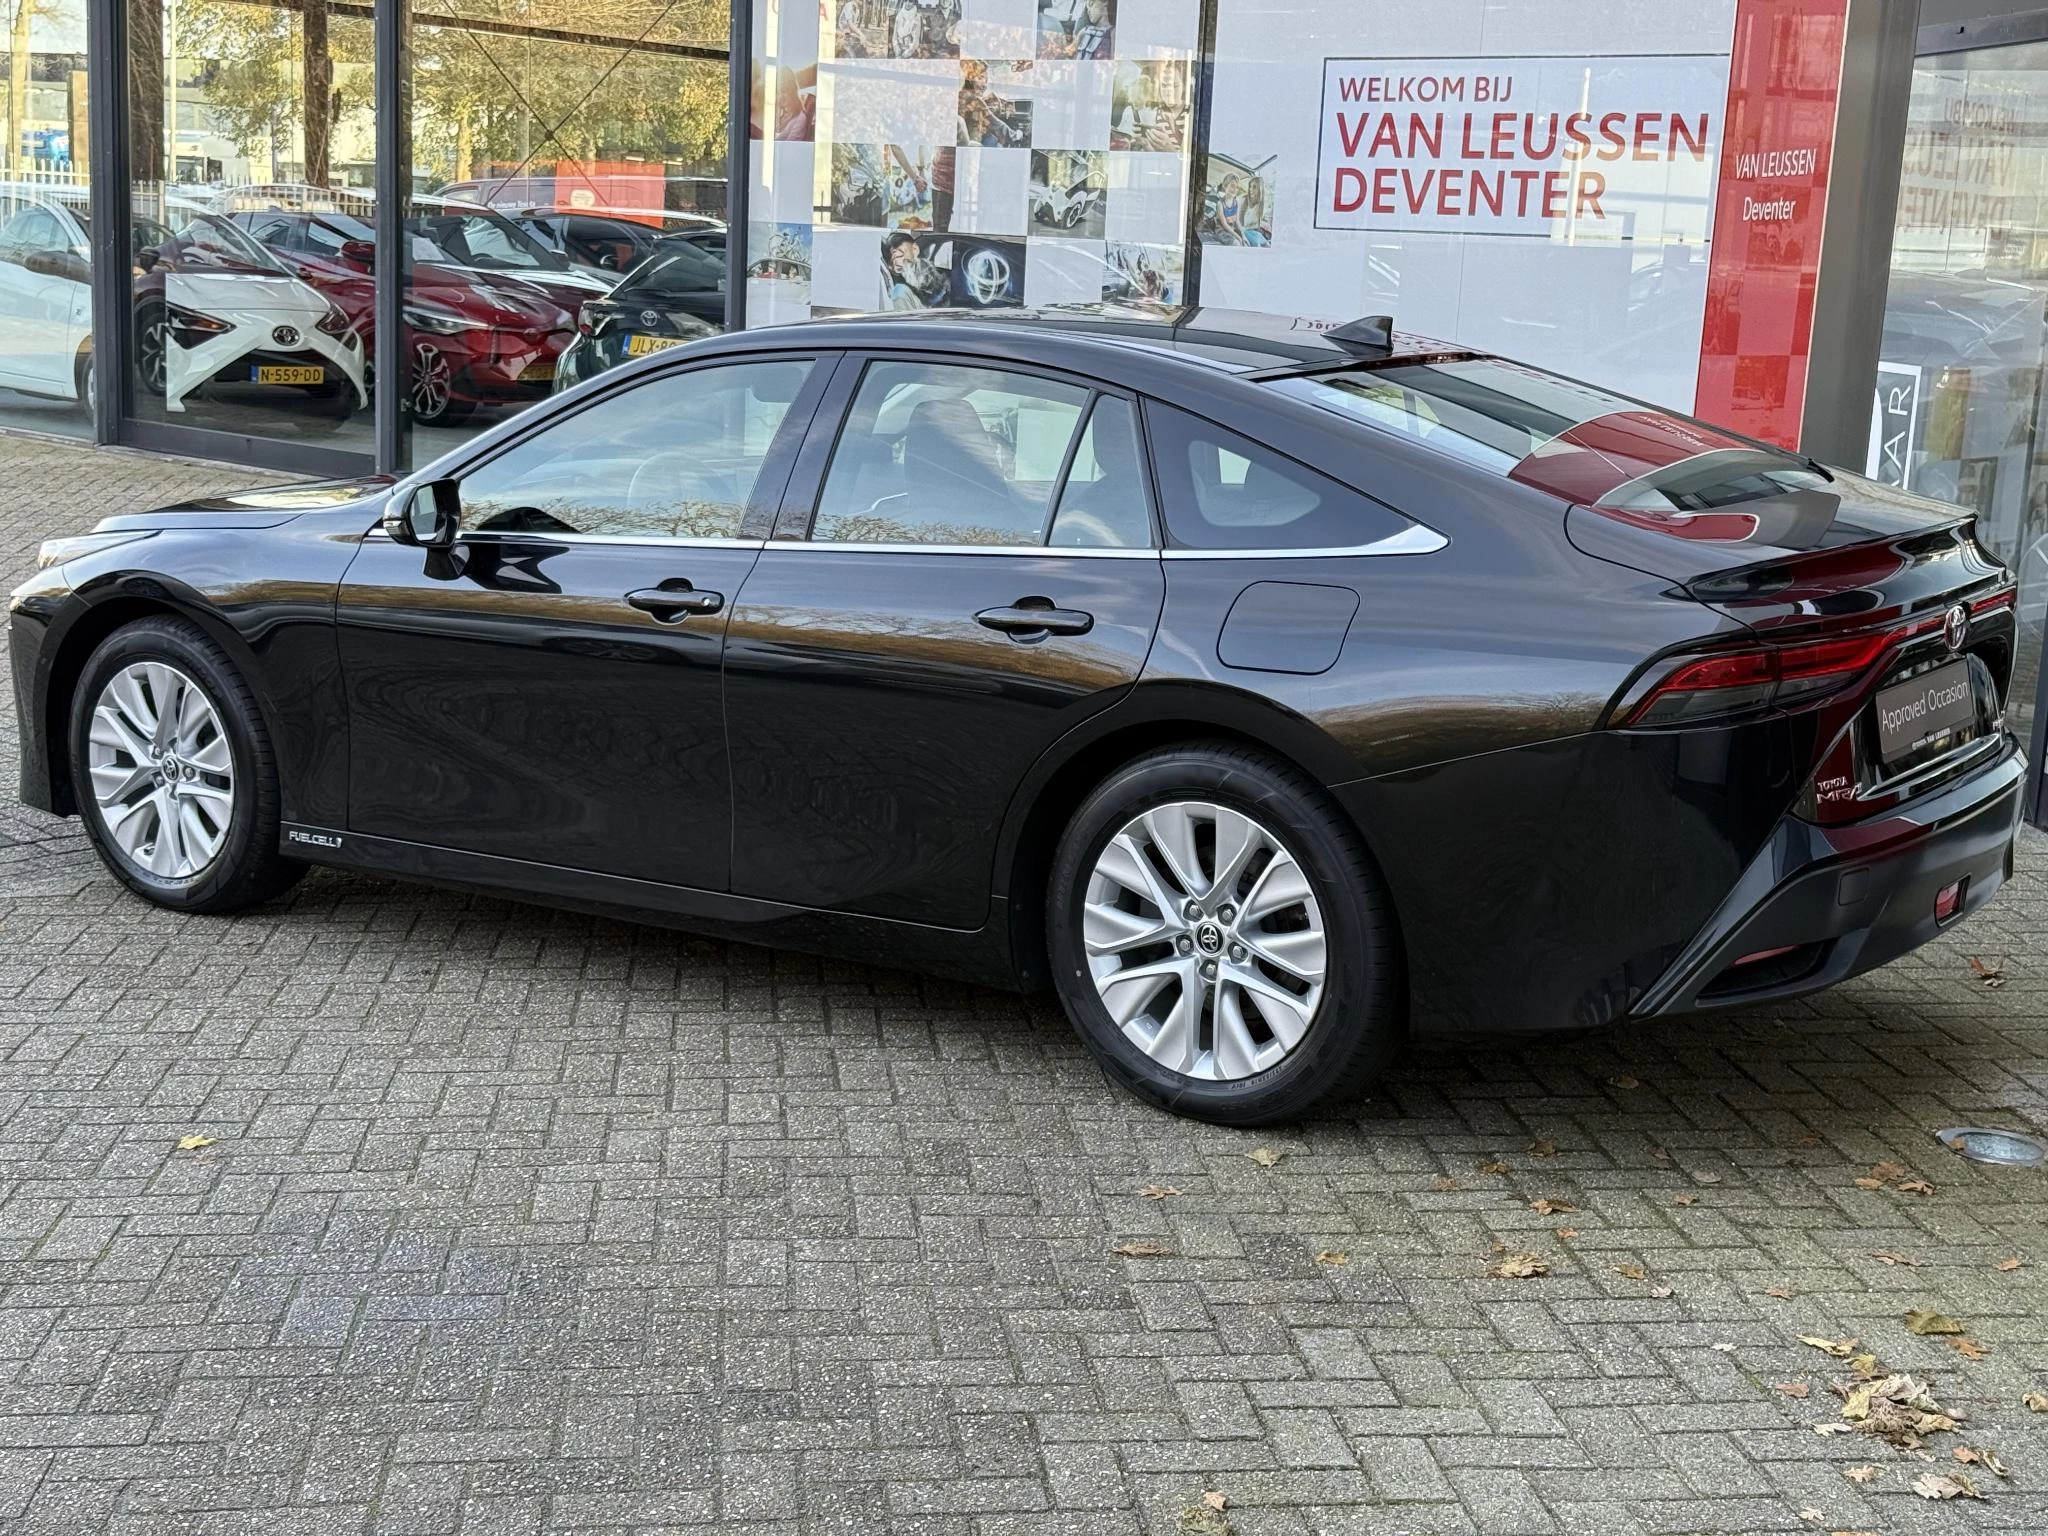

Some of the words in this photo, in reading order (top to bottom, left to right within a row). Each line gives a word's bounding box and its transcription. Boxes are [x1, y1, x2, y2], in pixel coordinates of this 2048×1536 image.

[1339, 76, 1465, 103] WELKOM
[1473, 75, 1513, 102] BIJ
[1336, 112, 1444, 159] VAN
[1461, 112, 1710, 162] LEUSSEN
[1735, 152, 1760, 180] VAN
[1761, 148, 1817, 178] LEUSSEN
[1333, 167, 1607, 220] DEVENTER
[1742, 196, 1797, 221] Deventer
[261, 368, 321, 382] N-559-DD
[1882, 692, 1926, 734] Approved
[1928, 680, 1969, 711] Occasion
